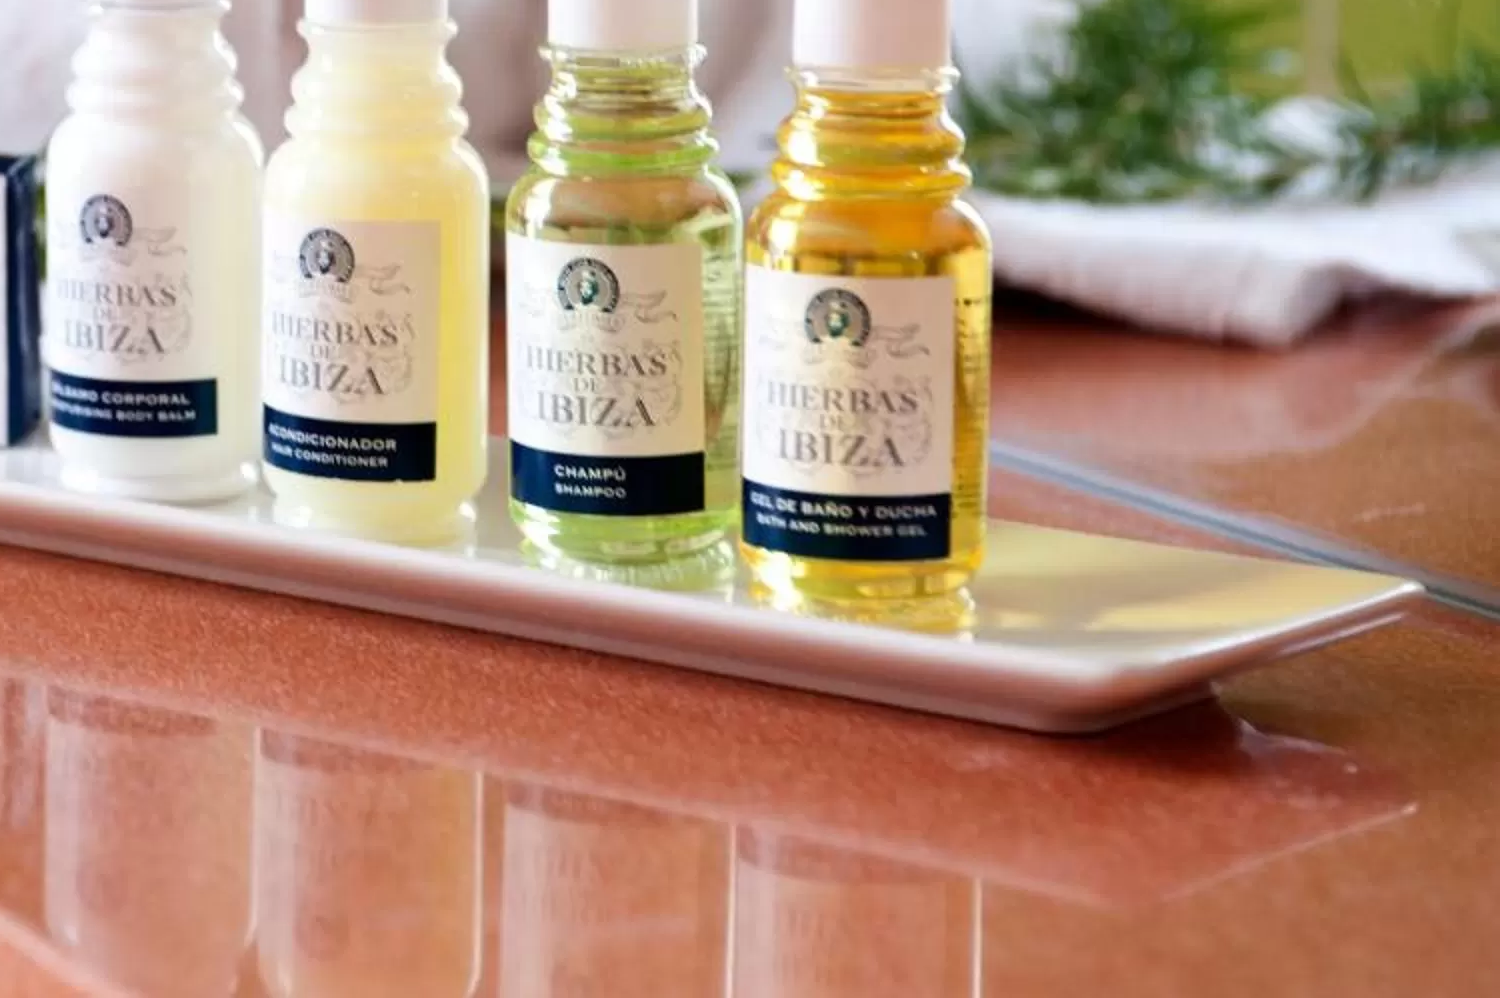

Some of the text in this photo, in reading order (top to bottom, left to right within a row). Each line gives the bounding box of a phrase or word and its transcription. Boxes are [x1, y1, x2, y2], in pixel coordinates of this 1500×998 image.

[63, 319, 165, 353] IBIZA
[271, 310, 399, 347] HIERBAS
[279, 353, 385, 395] IBIZA
[525, 345, 668, 377] HIERBAS
[102, 391, 190, 406] CORPORAL
[573, 377, 597, 394] DE
[766, 381, 919, 415] HIERBAS
[115, 409, 152, 422] BODY
[157, 409, 197, 422] BALM
[537, 390, 657, 428] IBIZA
[268, 422, 397, 451] ACONDICIONADOR
[777, 428, 905, 467] IBIZA
[295, 448, 389, 468] CONDITIONER
[553, 463, 627, 481] CHAMPÚ
[554, 481, 627, 498] SHAMPOO
[775, 497, 798, 514] DE
[801, 500, 852, 518] BAÑO
[857, 505, 869, 518] Y
[874, 505, 937, 520] DUCHA
[788, 519, 820, 534] AND
[822, 523, 893, 537] SHOWER
[896, 524, 928, 537] GEL
